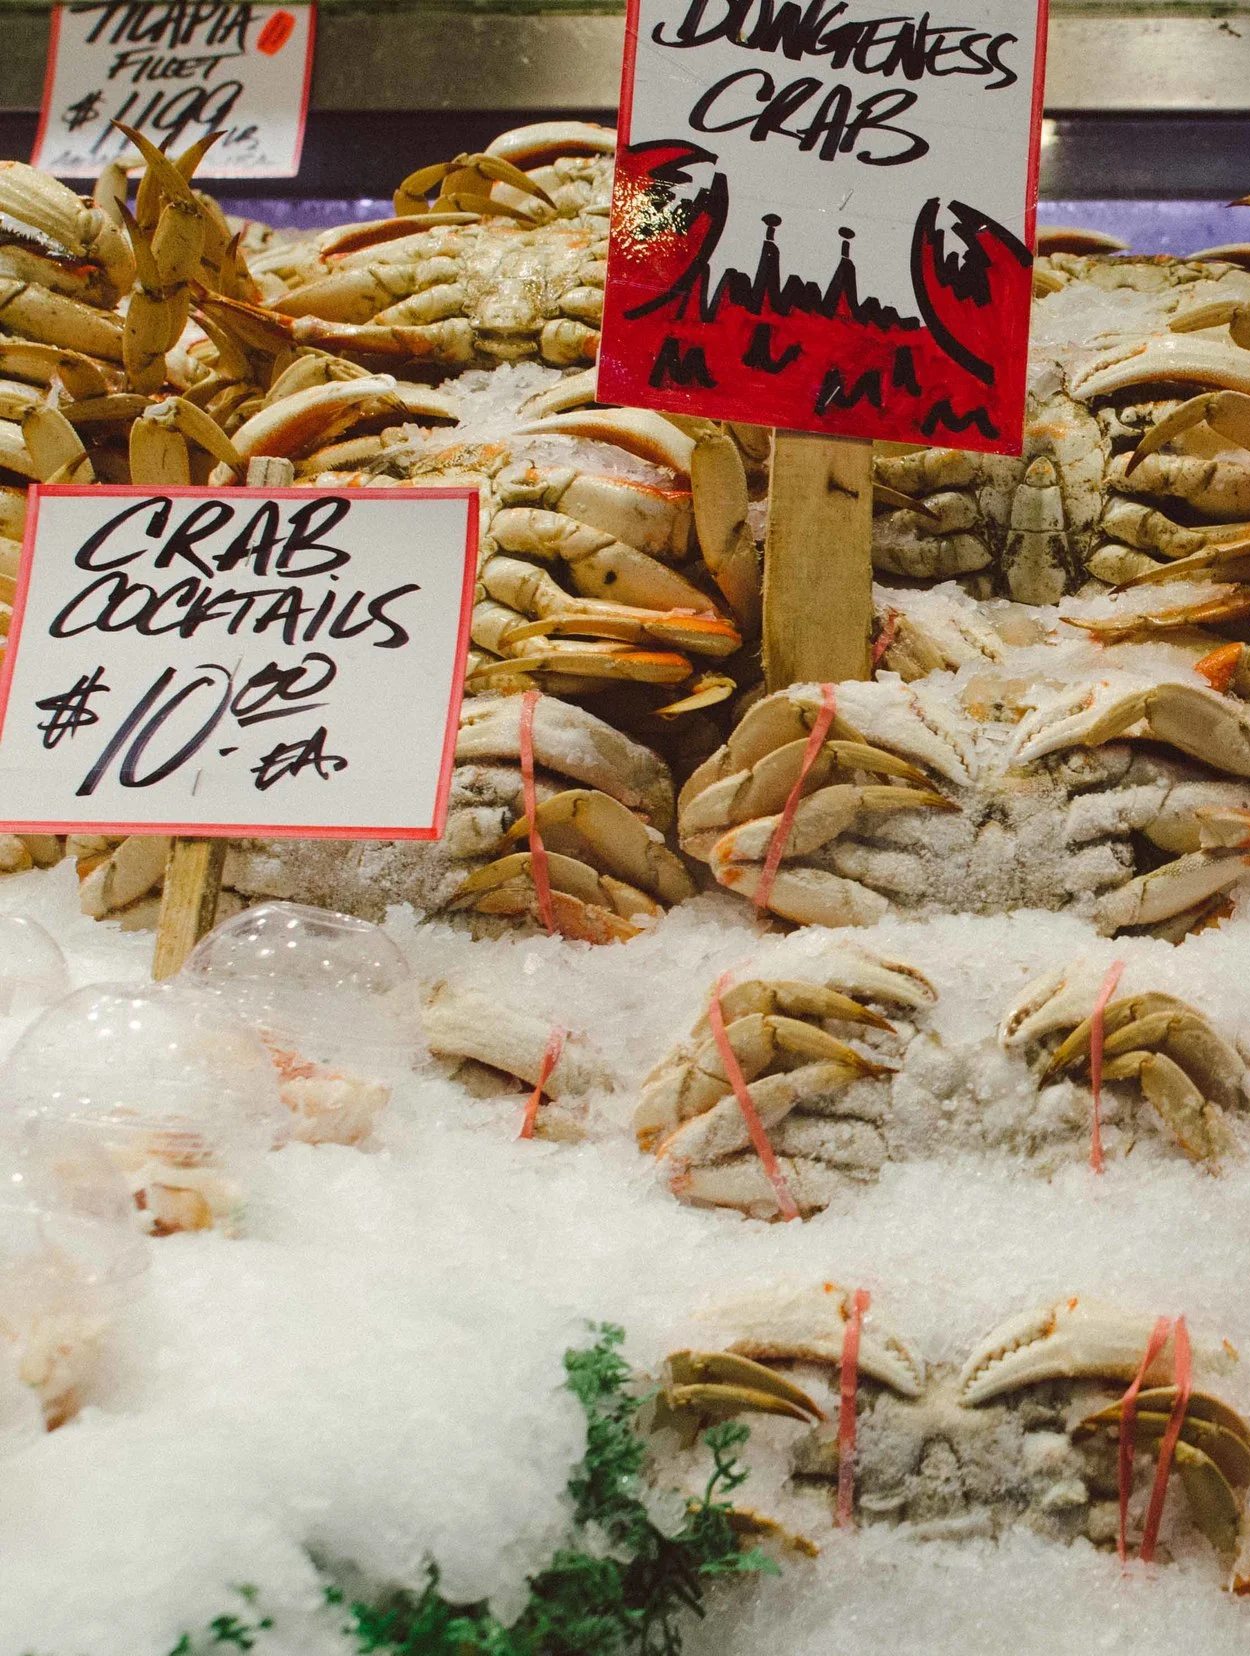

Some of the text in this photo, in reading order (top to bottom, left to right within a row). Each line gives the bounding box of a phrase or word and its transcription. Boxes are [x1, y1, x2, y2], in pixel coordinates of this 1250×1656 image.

[107, 46, 241, 83] FILLET
[651, 0, 1018, 90] DUNGENESS
[688, 68, 930, 166] CRAB
[75, 496, 352, 579] CRAB
[48, 571, 422, 648] COCKTAILS
